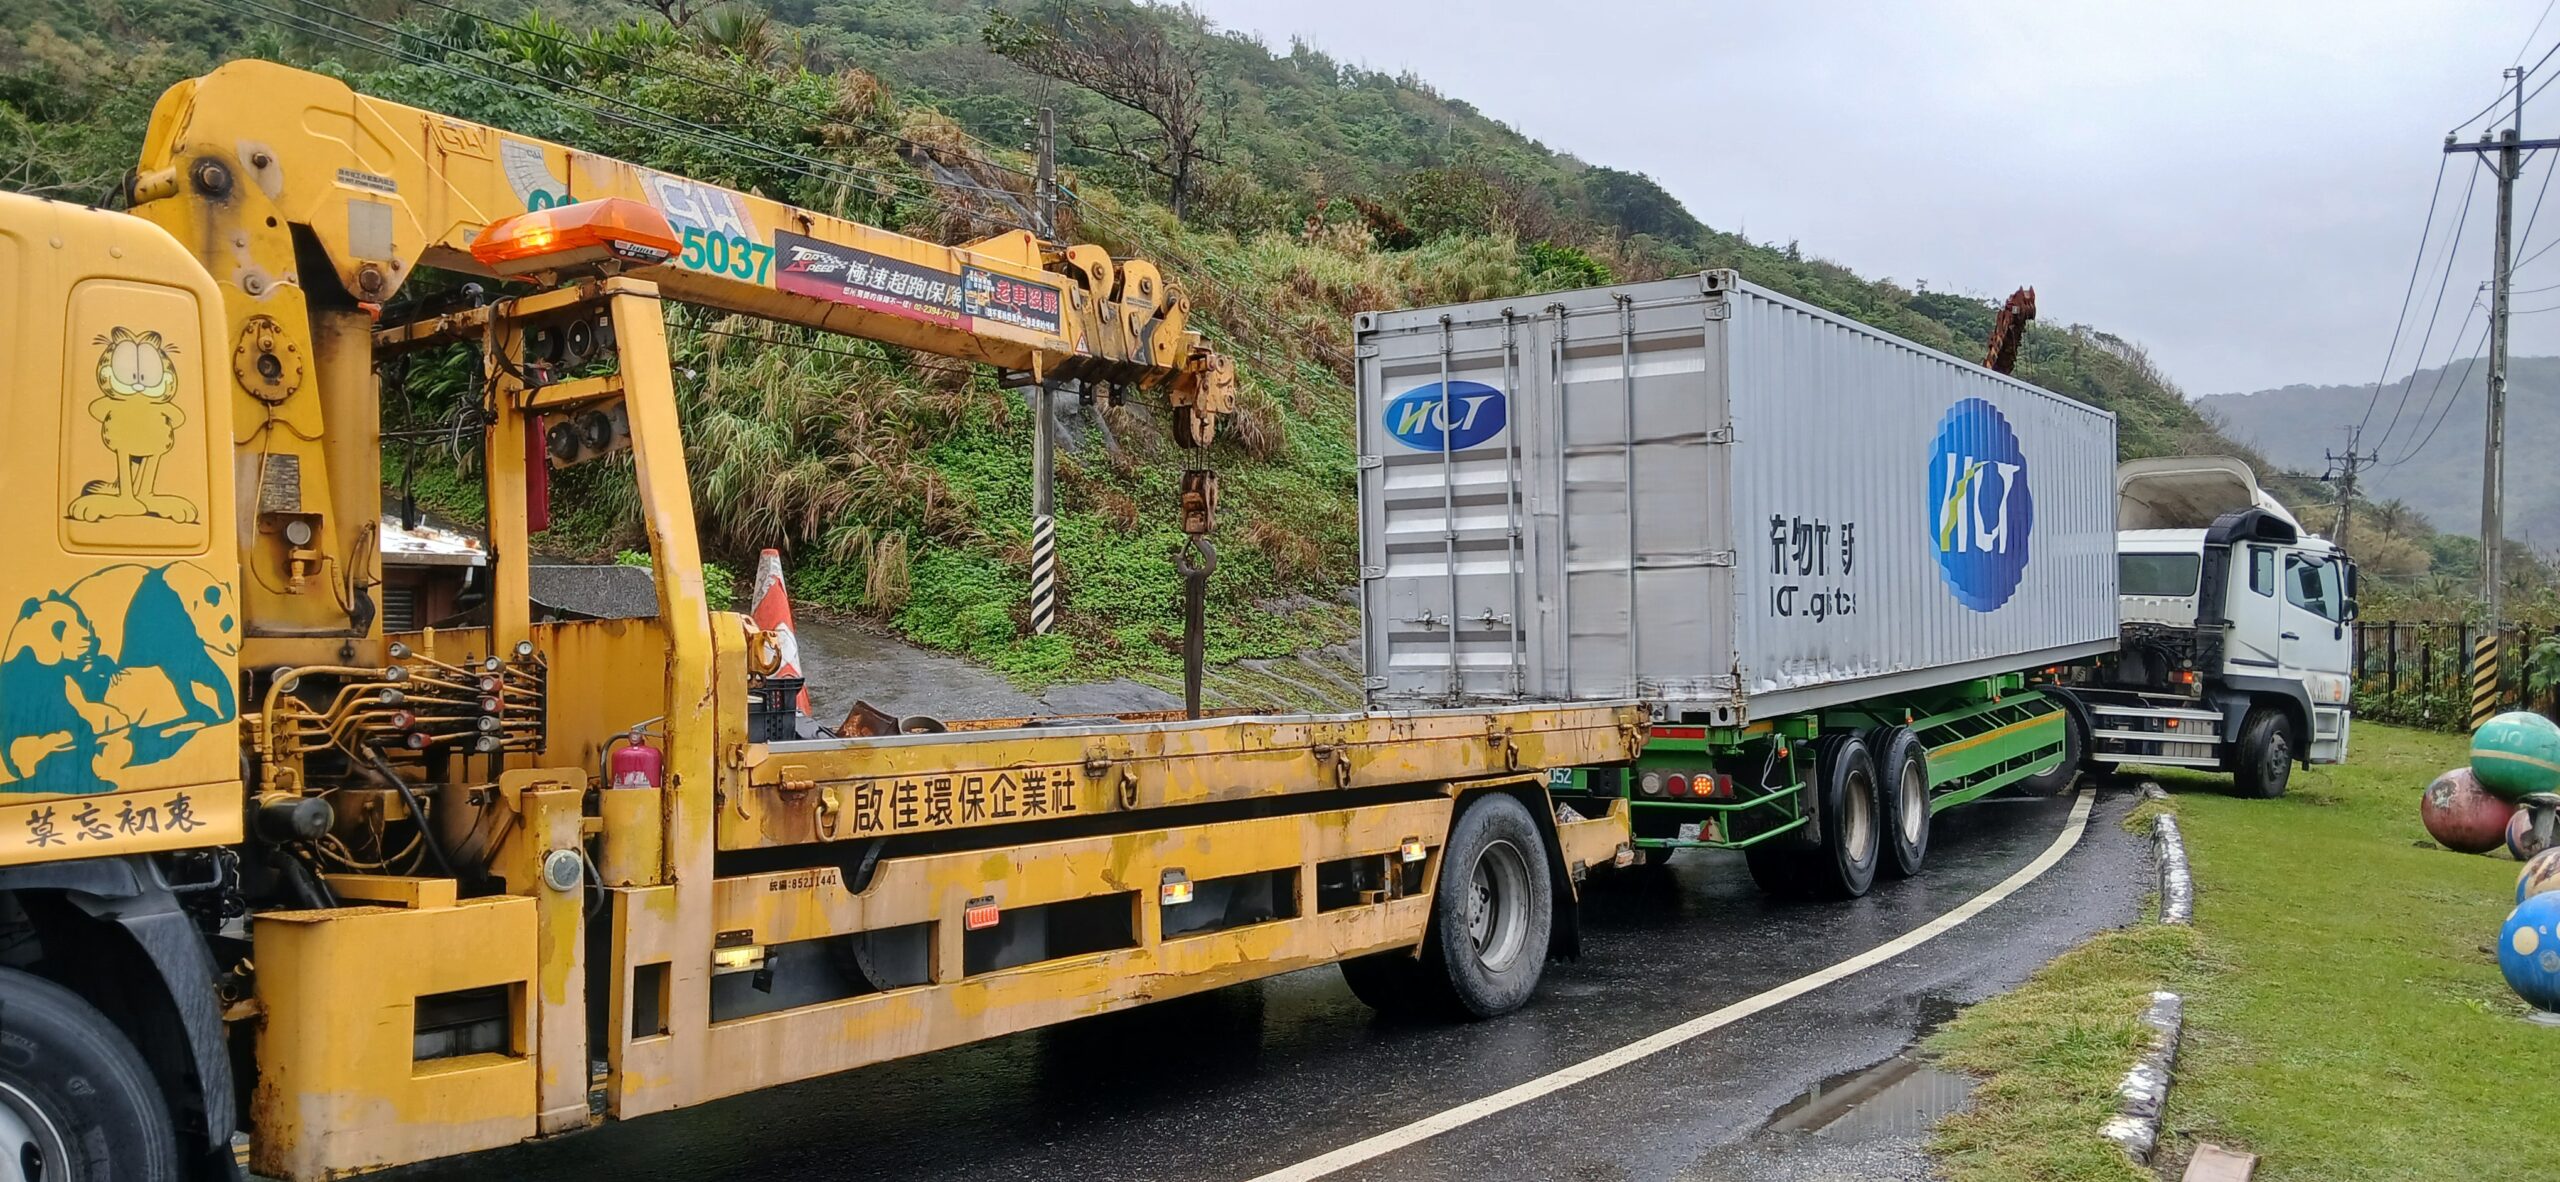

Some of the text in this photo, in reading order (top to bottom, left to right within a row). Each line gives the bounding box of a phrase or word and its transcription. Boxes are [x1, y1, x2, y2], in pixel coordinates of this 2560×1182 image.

[667, 219, 775, 285] 5037
[846, 261, 962, 308] 極速超跑保險
[1397, 394, 1495, 435] HCT
[26, 791, 207, 848] 莫忘初衷
[853, 768, 1077, 833] 啟佳環保企業社
